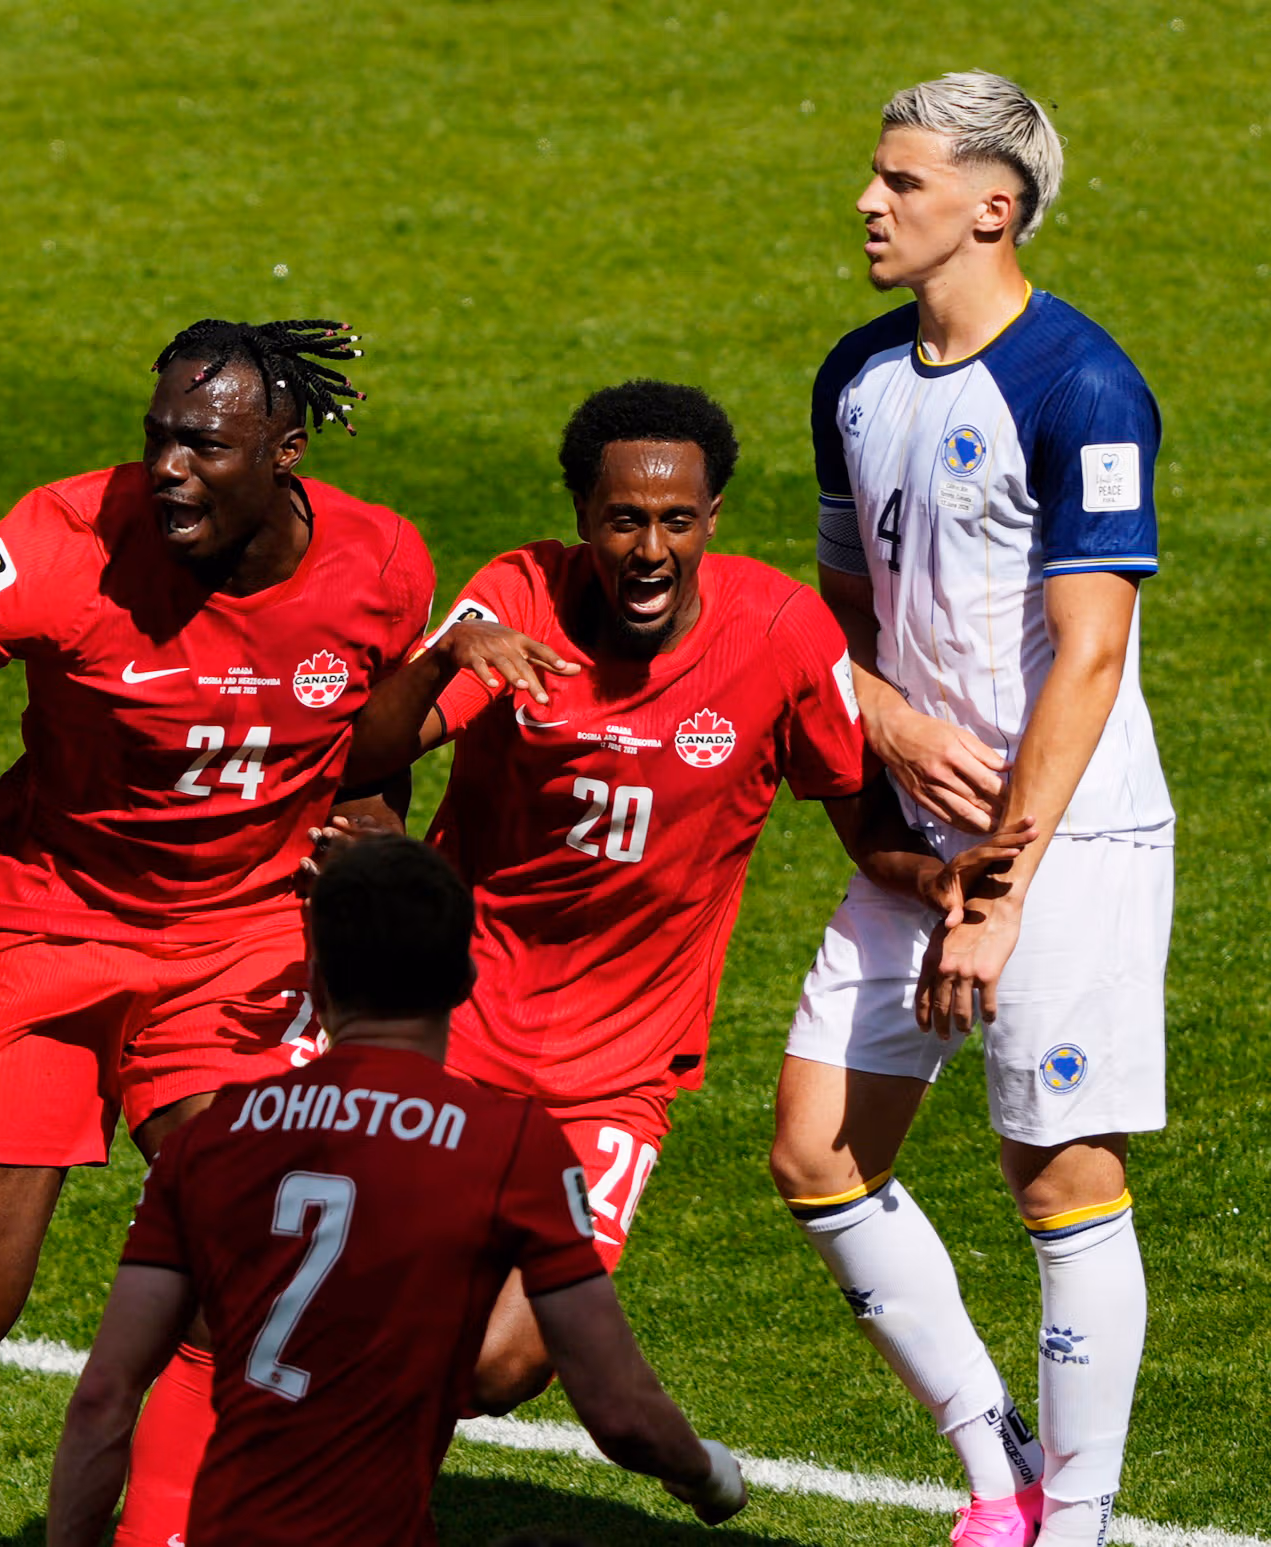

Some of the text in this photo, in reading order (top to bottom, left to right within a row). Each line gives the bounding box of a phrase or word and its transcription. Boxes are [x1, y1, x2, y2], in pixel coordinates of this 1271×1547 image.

[1099, 485, 1121, 496] PEACE
[877, 488, 903, 572] 4
[295, 675, 345, 685] CANADA
[174, 725, 272, 800] 24
[677, 735, 733, 745] CANADA
[566, 777, 653, 863] 20
[281, 989, 329, 1055] 2
[230, 1085, 467, 1150] JOHNSTON
[588, 1126, 658, 1236] 20
[245, 1170, 357, 1402] 2
